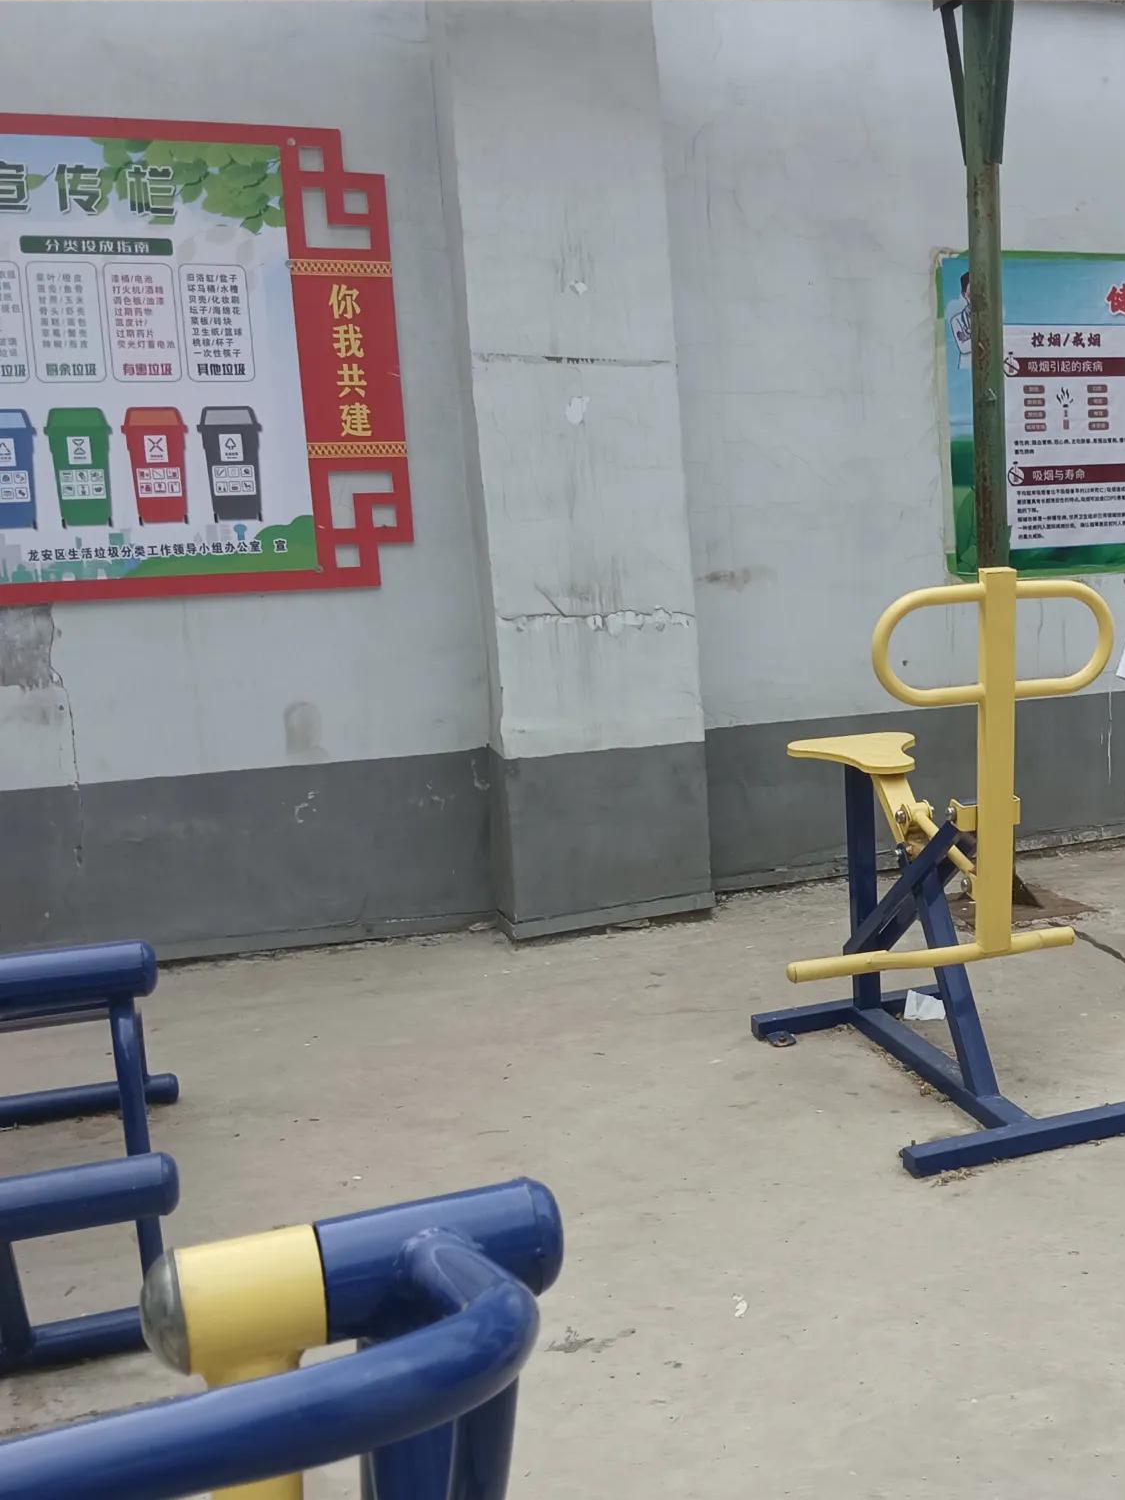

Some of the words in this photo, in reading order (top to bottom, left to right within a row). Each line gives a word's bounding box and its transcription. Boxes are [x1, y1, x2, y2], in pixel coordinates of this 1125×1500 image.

[45, 238, 150, 254] 分类投放指南
[1031, 331, 1102, 349] 控烟/戒烟
[328, 283, 373, 438] 你我共建
[1027, 360, 1104, 373] 吸烟引起的疾病
[122, 363, 173, 377] 有害垃圾
[197, 363, 246, 377] 其他垃圾
[1032, 468, 1086, 482] 吸烟与寿命
[27, 540, 262, 563] 龙安区生活垃圾分类工作领导小组办公室
